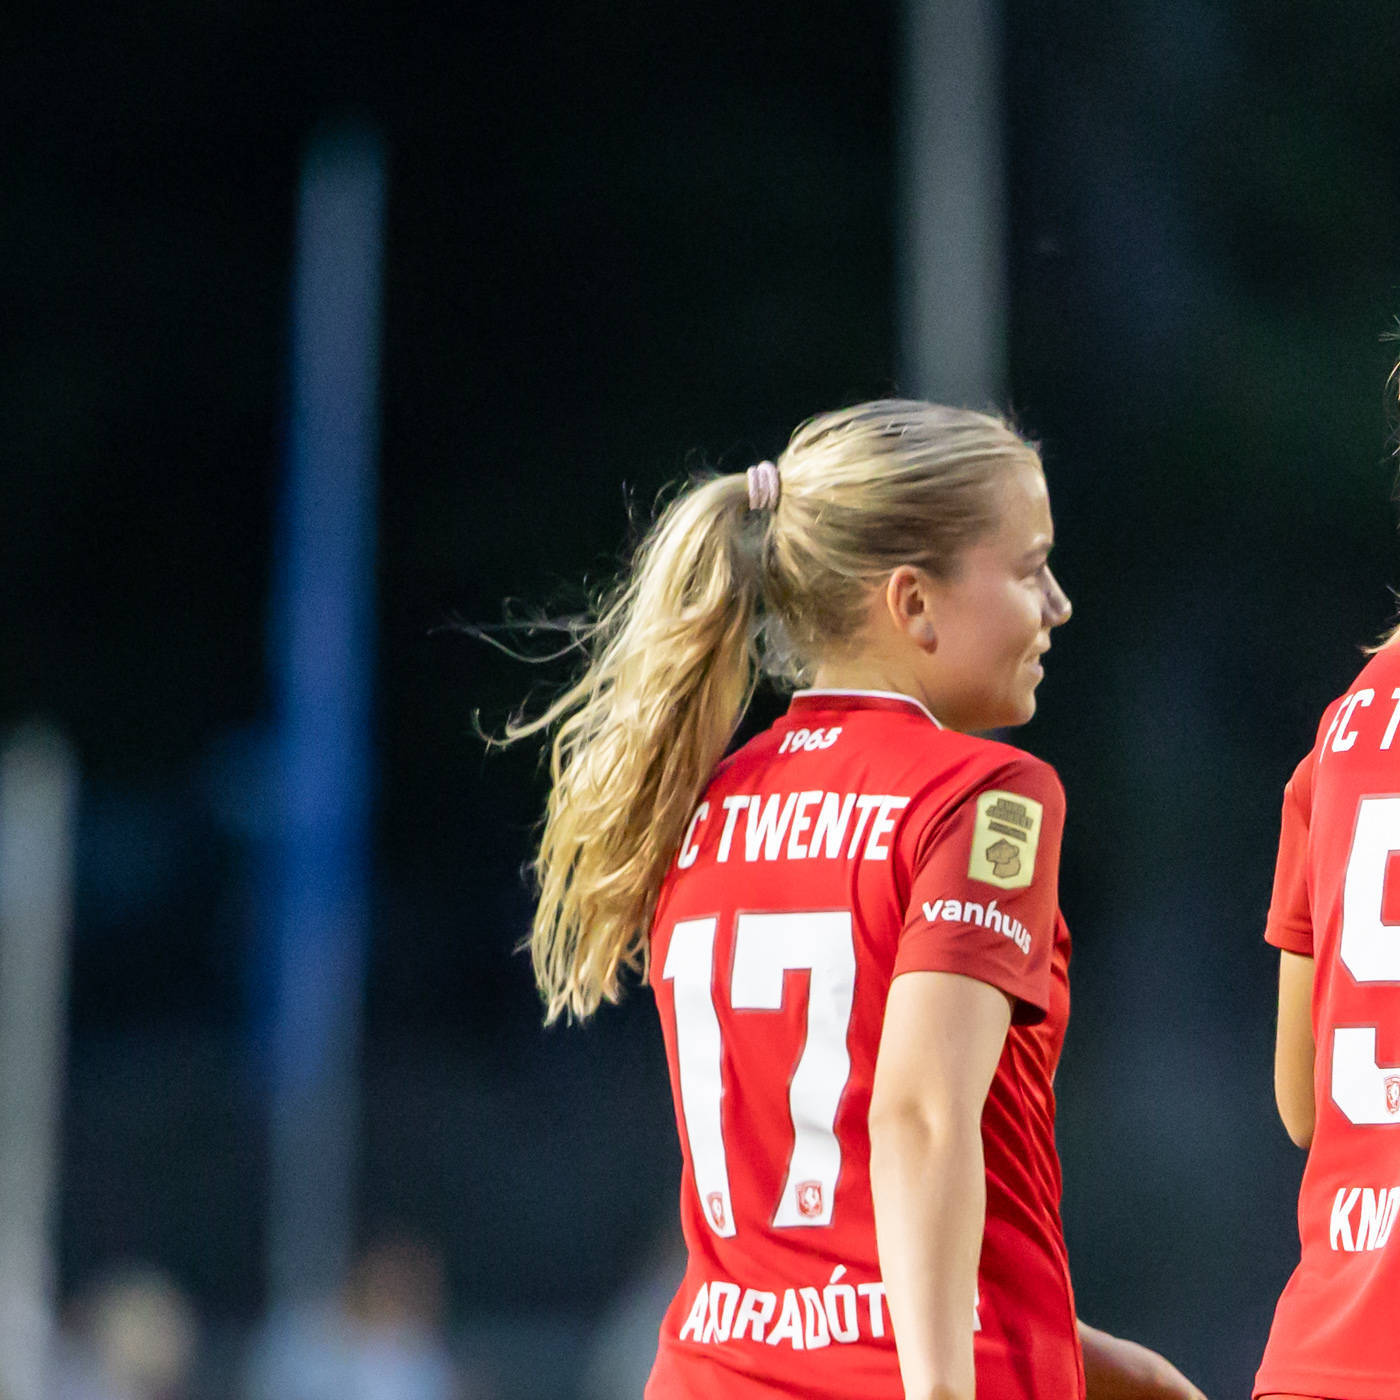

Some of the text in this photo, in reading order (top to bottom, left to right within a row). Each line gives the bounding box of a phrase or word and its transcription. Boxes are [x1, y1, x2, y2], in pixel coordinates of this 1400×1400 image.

[777, 727, 842, 754] 1965
[1319, 688, 1375, 753] FC
[717, 790, 911, 863] TWENTE
[922, 899, 1032, 955] vanhuus
[662, 911, 857, 1238] 17
